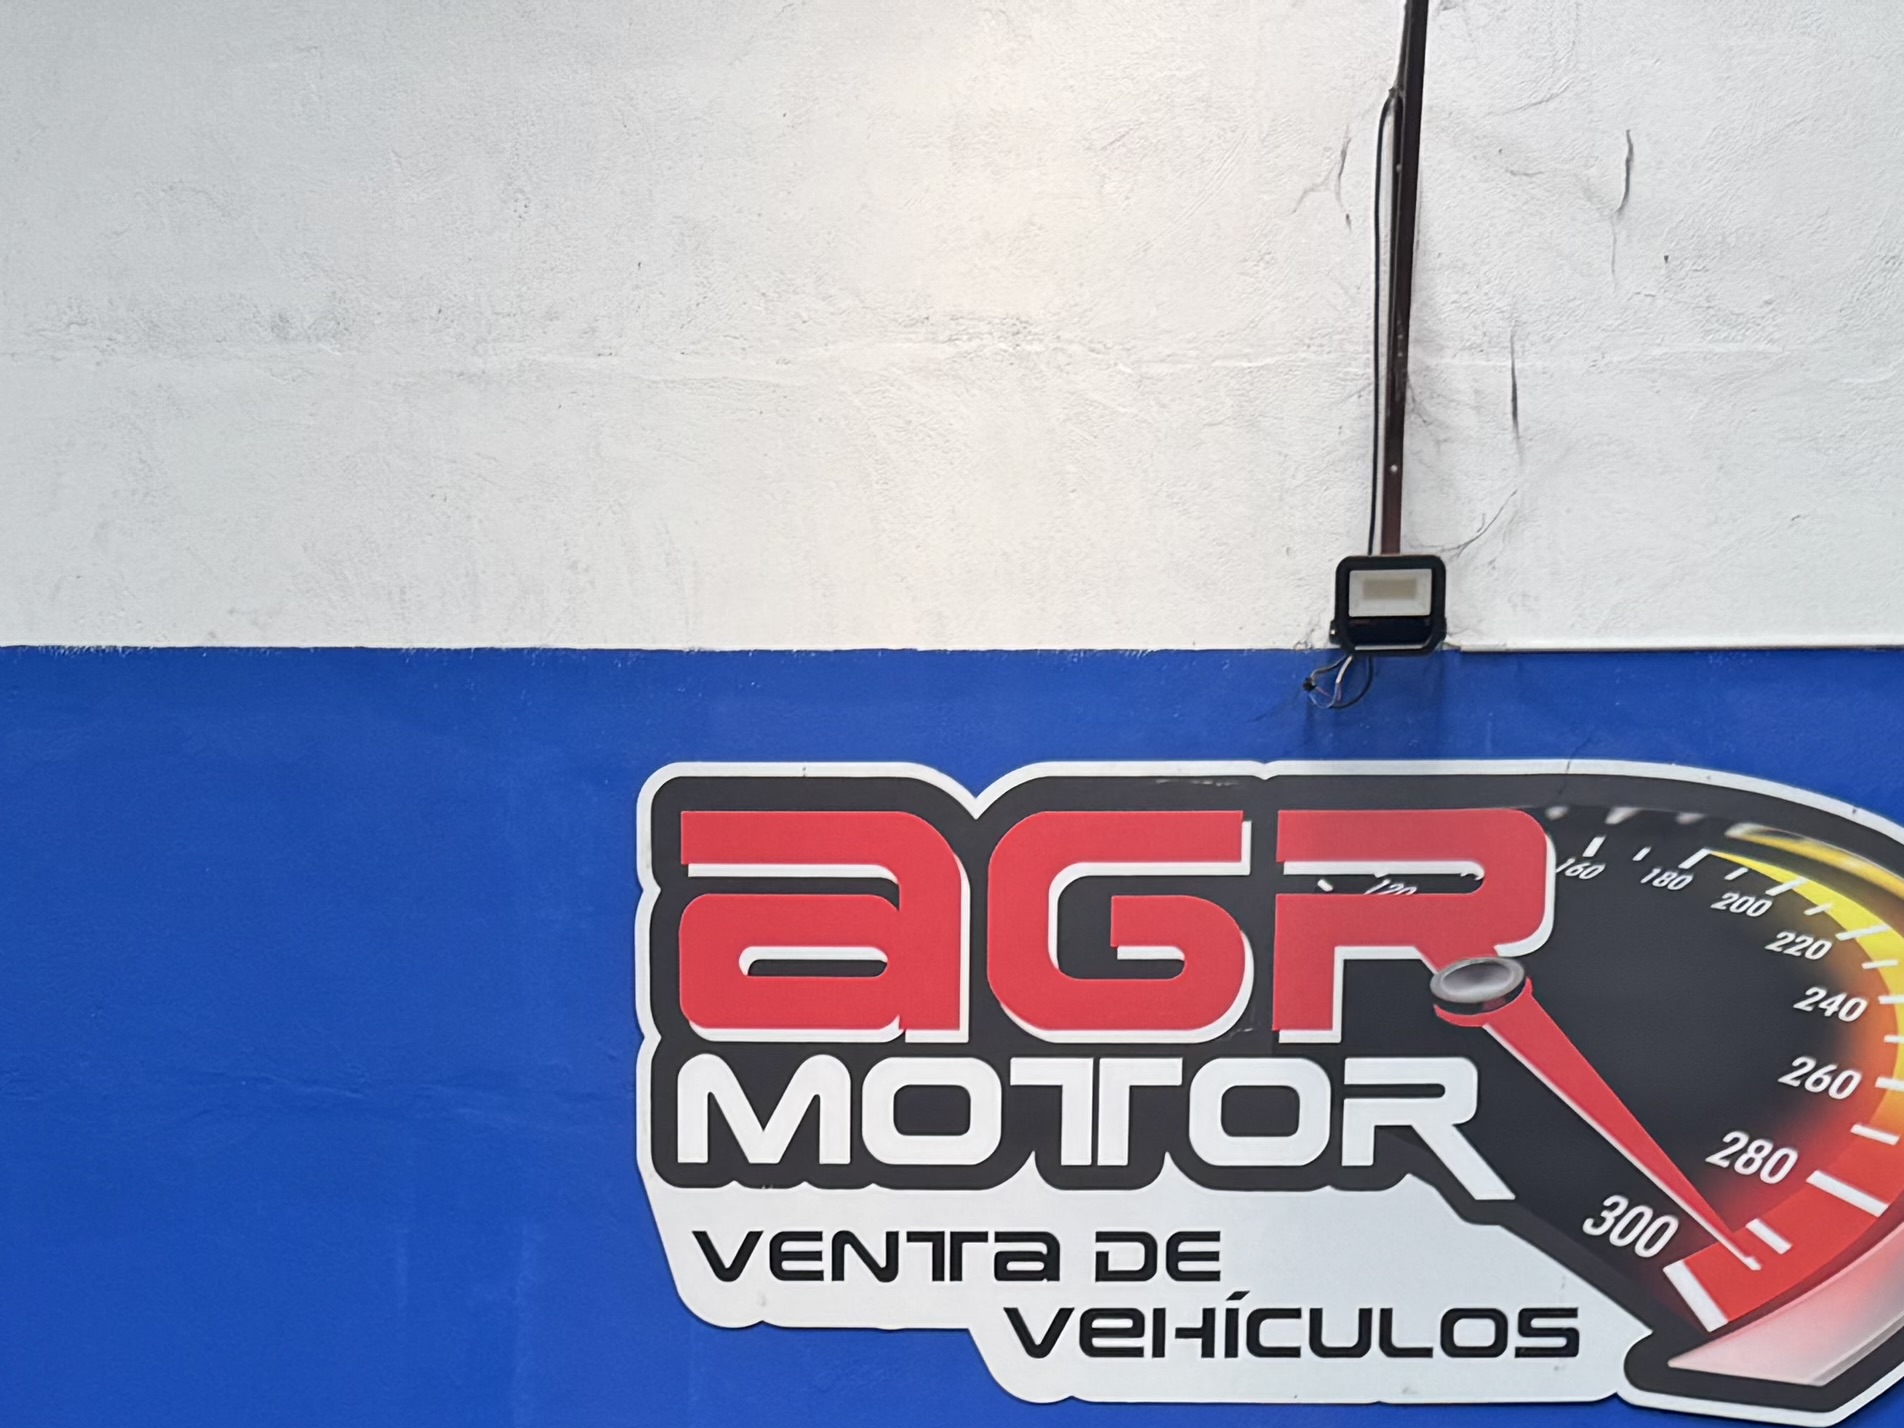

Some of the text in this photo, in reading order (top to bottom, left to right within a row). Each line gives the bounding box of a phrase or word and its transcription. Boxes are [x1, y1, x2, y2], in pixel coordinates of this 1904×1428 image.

[1556, 857, 1606, 880] 160
[1640, 867, 1694, 890] 180
[1711, 892, 1773, 917] 200
[1764, 931, 1833, 960] 220
[1793, 986, 1869, 1022] 240
[1777, 1056, 1862, 1100] 260
[677, 1053, 1515, 1200] MOTOR
[1705, 1131, 1799, 1184] 280
[1582, 1195, 1679, 1258] 300
[1095, 1230, 1221, 1282] DE
